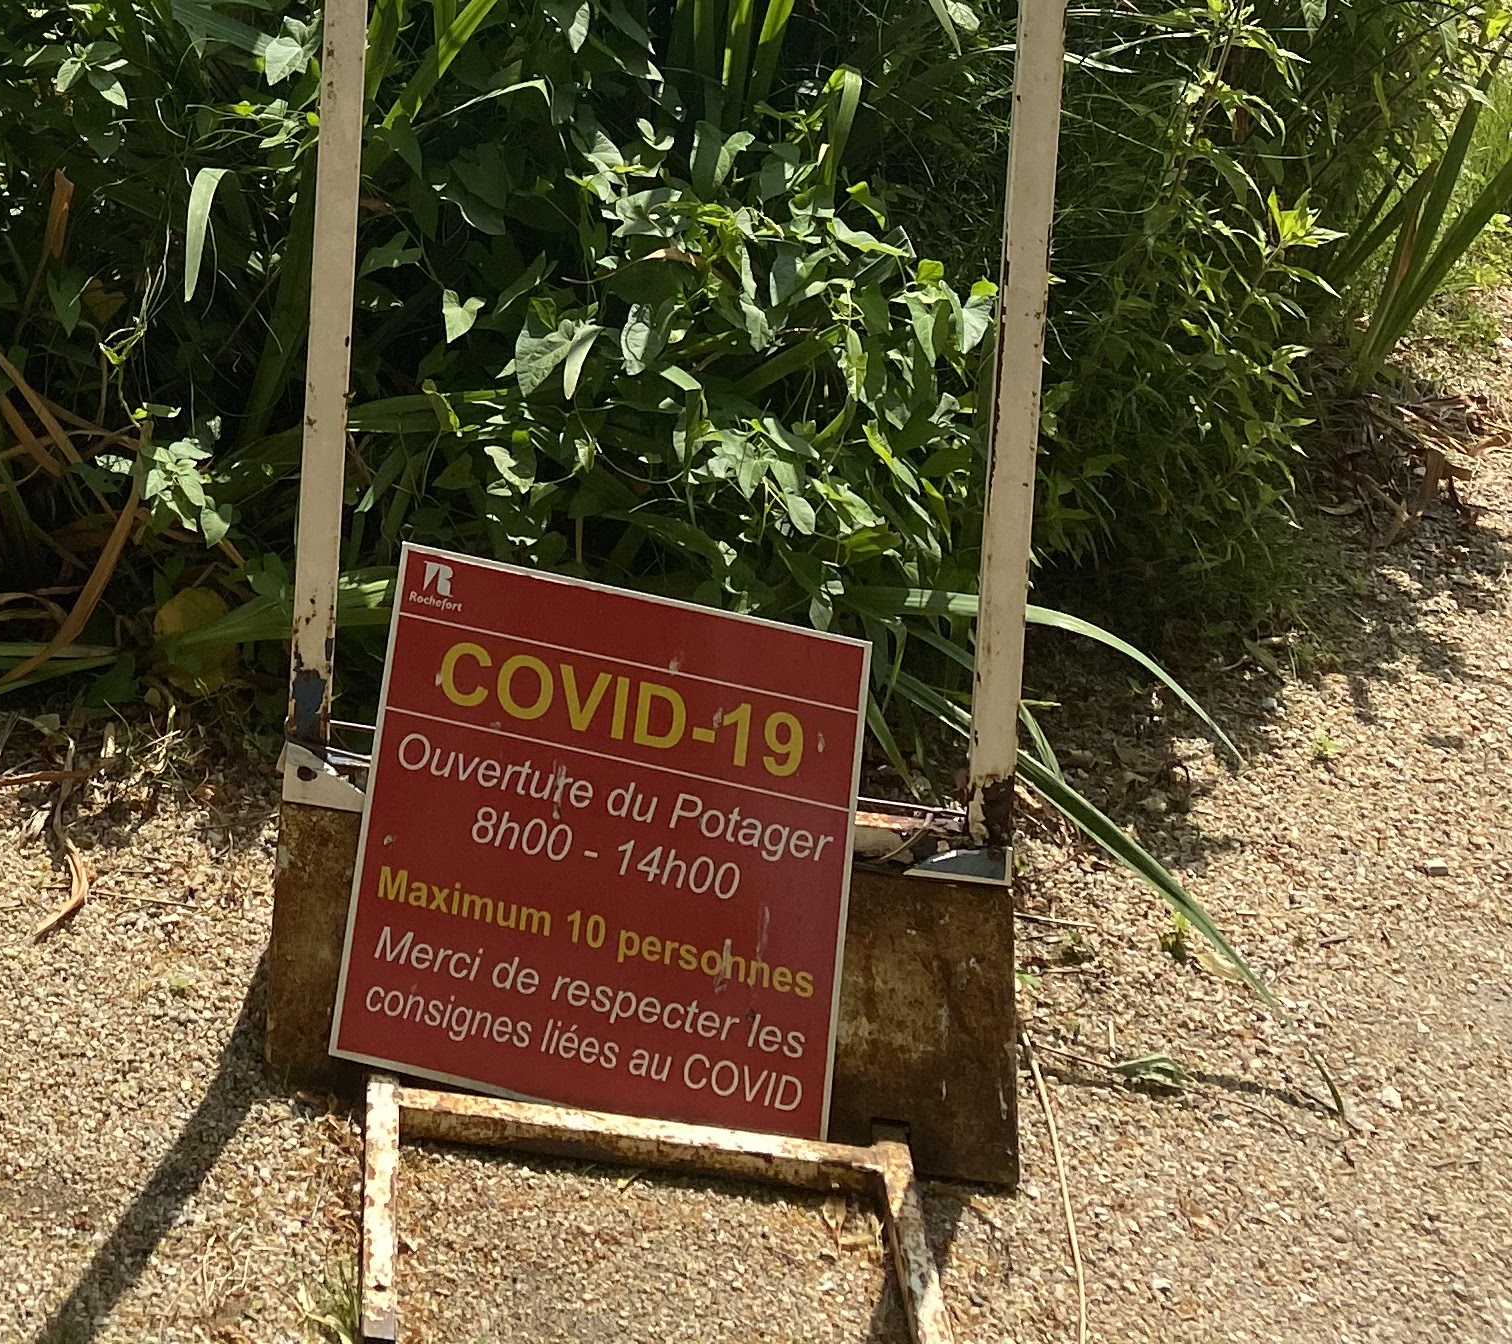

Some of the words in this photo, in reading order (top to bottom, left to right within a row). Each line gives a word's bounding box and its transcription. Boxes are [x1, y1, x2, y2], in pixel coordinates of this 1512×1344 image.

[408, 590, 463, 612] Rochefort
[440, 641, 804, 777] COVID-19
[397, 732, 594, 809] Ouverture
[606, 781, 658, 824] du
[668, 792, 835, 862] Potager
[471, 806, 573, 862] 8h00
[583, 849, 599, 859] -
[617, 839, 741, 900] 14h00
[373, 925, 484, 981] Merci
[491, 956, 540, 995] de
[550, 975, 740, 1041] respecter
[746, 1013, 807, 1059] les
[377, 865, 552, 937] Maximum
[566, 909, 607, 949] 10
[616, 929, 815, 998] personnes
[365, 985, 533, 1048] consignes
[539, 1018, 620, 1069] liées
[628, 1047, 673, 1083] au
[683, 1053, 803, 1112] COVID
